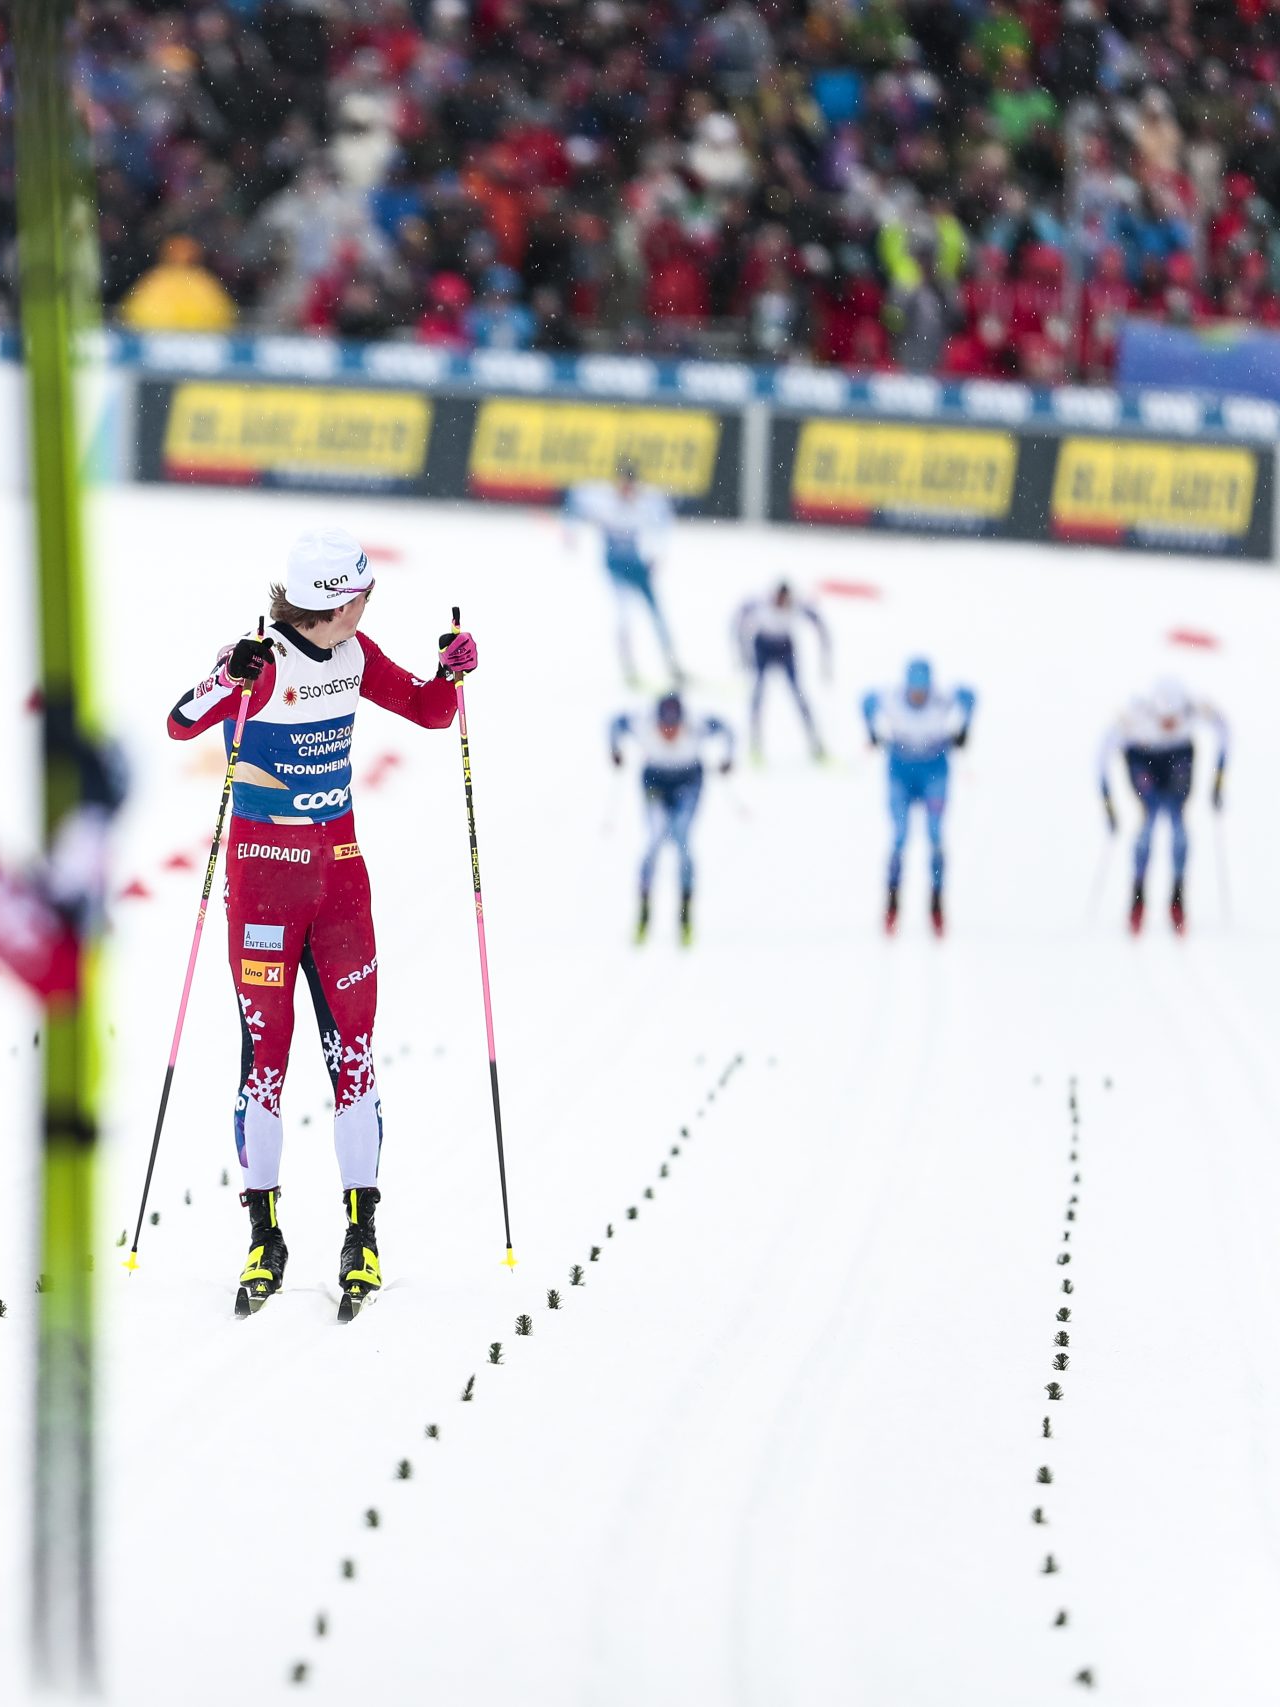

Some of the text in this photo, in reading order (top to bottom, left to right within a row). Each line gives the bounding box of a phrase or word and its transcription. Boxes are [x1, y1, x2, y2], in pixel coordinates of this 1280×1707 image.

[299, 674, 361, 700] StoraEnso
[289, 729, 337, 745] WORLD
[223, 751, 239, 794] LEKI
[461, 743, 472, 786] LEKI
[237, 843, 311, 865] ELDORADO
[245, 940, 282, 949] ENTELIOS
[244, 967, 263, 978] Uno
[336, 954, 378, 990] CRAF
